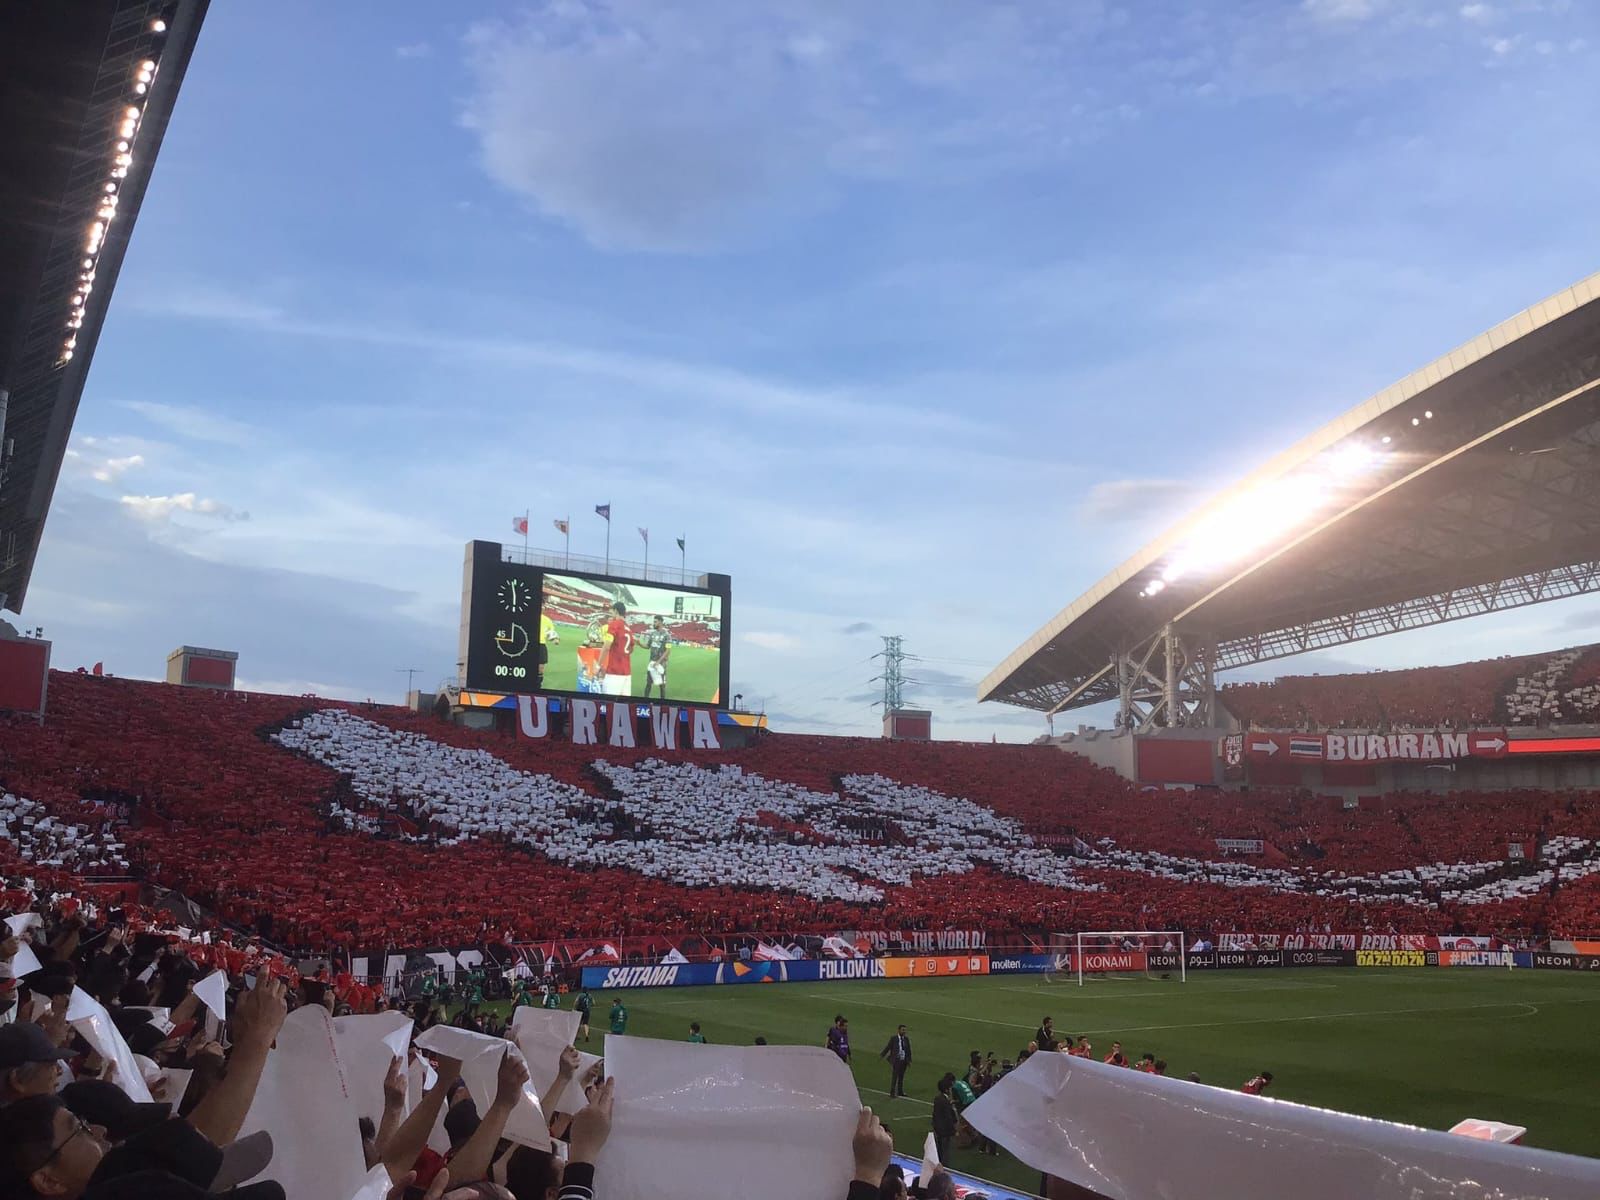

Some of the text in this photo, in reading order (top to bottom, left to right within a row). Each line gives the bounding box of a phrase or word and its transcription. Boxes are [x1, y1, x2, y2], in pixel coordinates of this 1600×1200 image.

[496, 630, 506, 638] 45
[495, 665, 526, 678] 00:00
[519, 696, 720, 750] URAWA
[1326, 733, 1471, 761] BURIRAM
[912, 931, 934, 951] THE
[937, 931, 986, 950] WORLD!
[1284, 934, 1305, 950] GO
[991, 959, 1022, 970] molten
[1085, 955, 1132, 968] KONAMI
[1150, 956, 1176, 966] NEOM
[1220, 955, 1245, 964] NEOM
[1392, 955, 1426, 966] DAZN
[1449, 951, 1517, 966] #ACLFINAL
[1536, 956, 1571, 966] NEOM
[819, 958, 886, 979] FOLLOW US
[602, 965, 680, 987] SAITAMA
